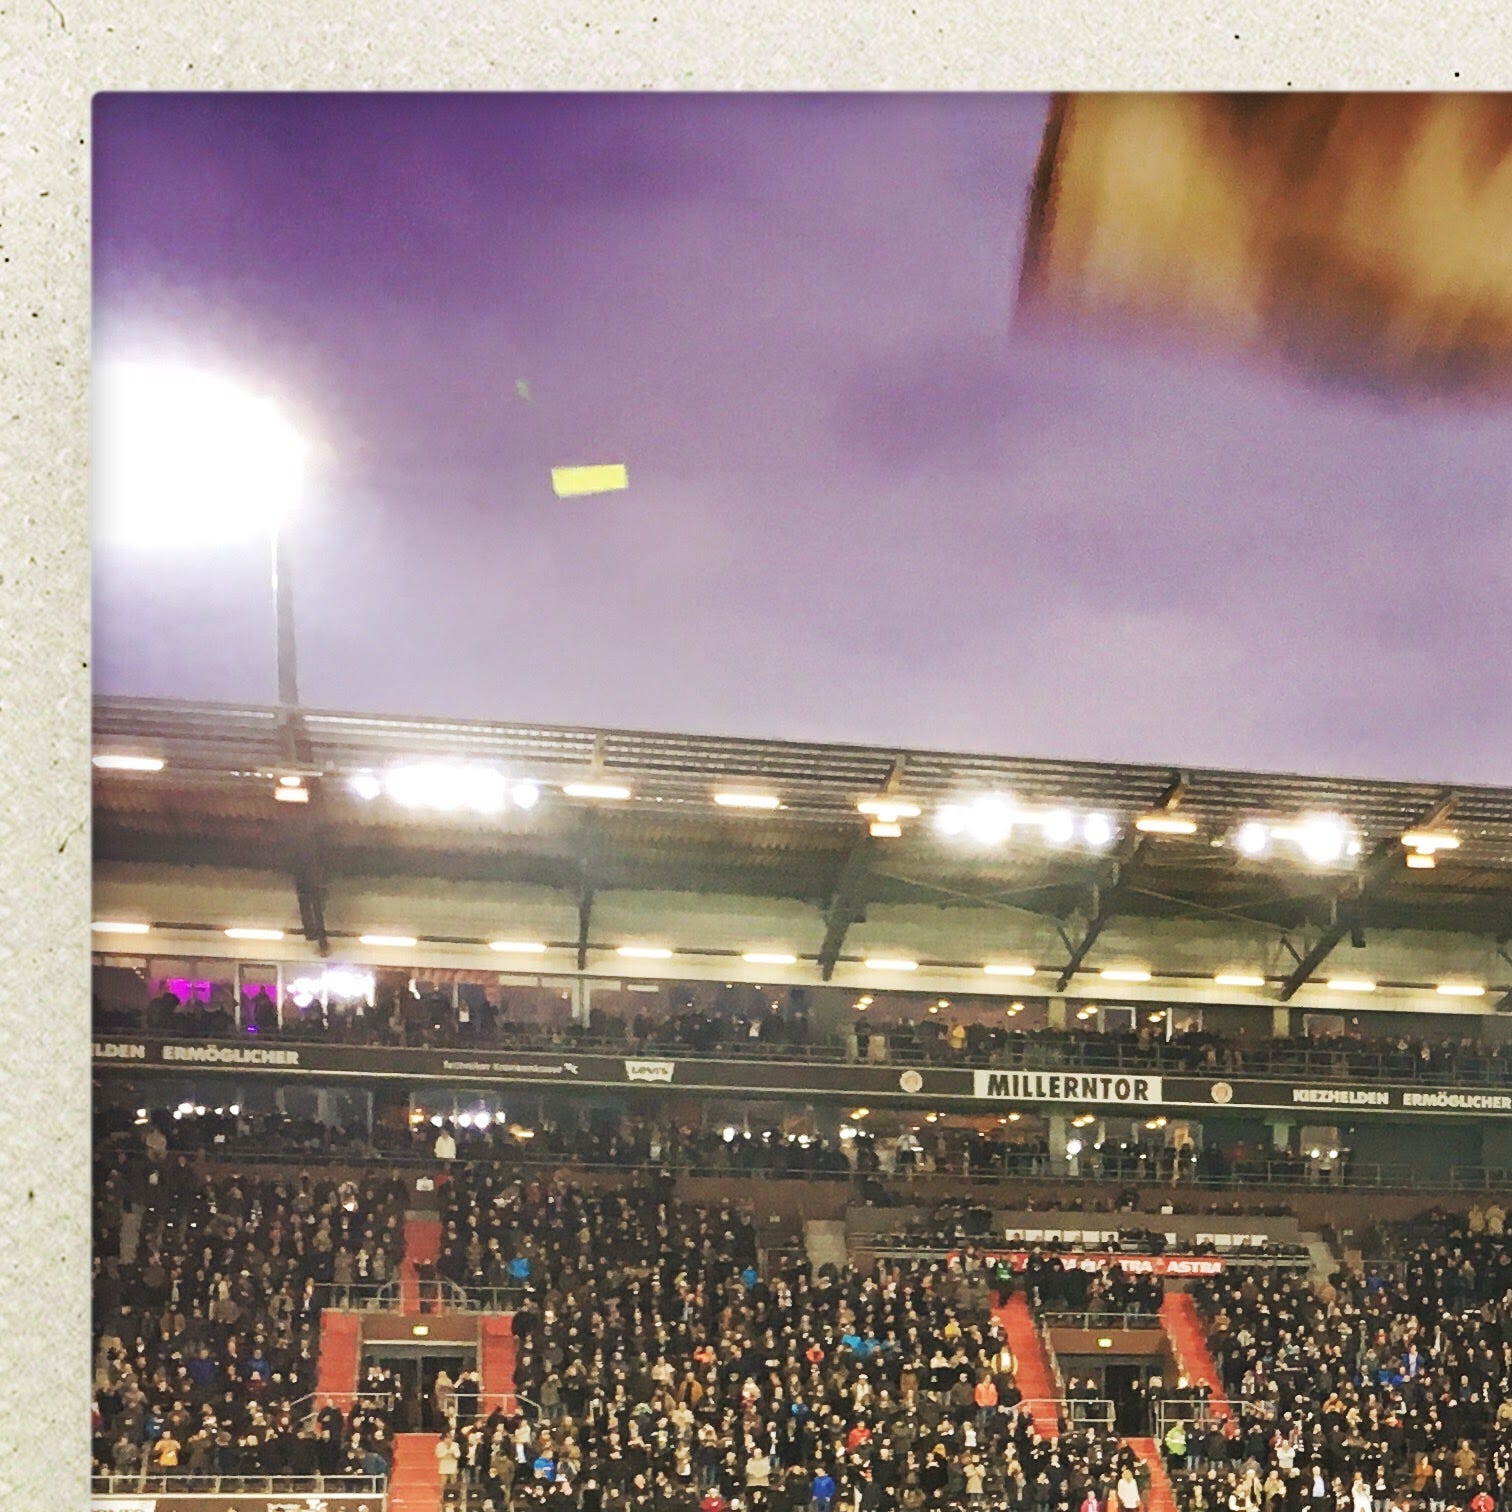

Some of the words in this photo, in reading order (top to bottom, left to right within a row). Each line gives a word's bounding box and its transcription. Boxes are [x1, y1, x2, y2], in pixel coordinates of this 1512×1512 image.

[92, 1043, 146, 1059] LDEN
[162, 1044, 299, 1064] ERMÖGLICHER
[987, 1073, 1150, 1101] MILLERNTOR
[1292, 1088, 1389, 1105] KIEZHELDEN
[1403, 1091, 1512, 1110] ERMÖGLICHER
[1167, 1260, 1222, 1274] ASTRA
